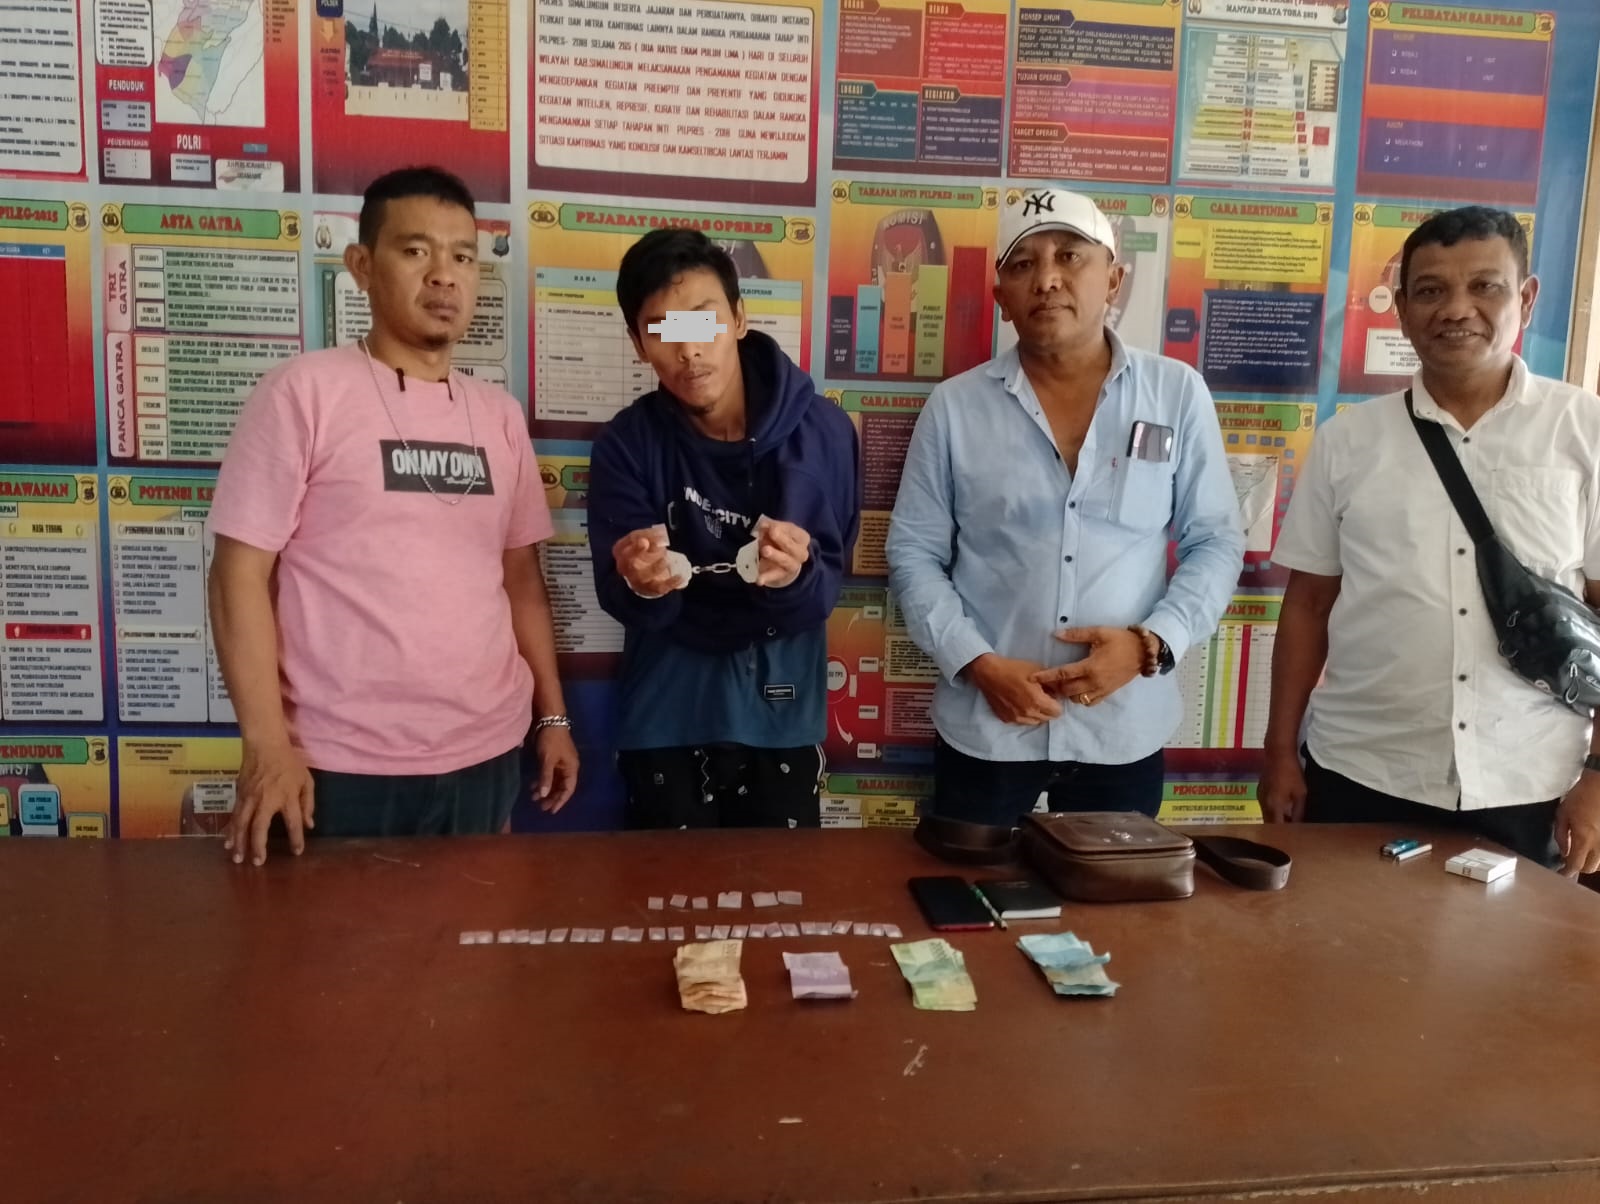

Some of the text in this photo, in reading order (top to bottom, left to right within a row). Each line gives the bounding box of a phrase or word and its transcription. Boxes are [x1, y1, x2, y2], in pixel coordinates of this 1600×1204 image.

[1402, 8, 1467, 23] PELIBATAN
[676, 26, 698, 36] DALAM
[591, 39, 615, 49] SELAMA
[539, 54, 570, 65] WILAYAH
[745, 69, 777, 81] KEGIATAN
[109, 79, 145, 91] PENDUDUK
[604, 80, 637, 91] KEGIATAN
[749, 90, 767, 100] YANG
[539, 95, 572, 106] KEGIATAN
[753, 111, 775, 121] DALAM
[594, 119, 618, 129] SETIAP
[622, 121, 653, 132] TAHAPAN
[177, 134, 201, 150] POLRI
[539, 135, 566, 145] SITUASI
[608, 140, 626, 151] YANG
[757, 150, 788, 161] TERJAMIN
[1210, 202, 1298, 218] CARA BERTINDAK
[160, 214, 243, 233] ASTA GATRA
[576, 211, 647, 228] PEJABAT
[109, 272, 117, 302] TRI
[119, 260, 128, 315] GATRA
[115, 341, 126, 452] PANCA GATRA
[861, 395, 889, 407] CARA
[392, 449, 486, 479] ON MY OWN
[138, 485, 193, 501] POTENSI
[0, 744, 64, 759] ENDUDUK
[1173, 784, 1248, 796] PENGENDALIAN
